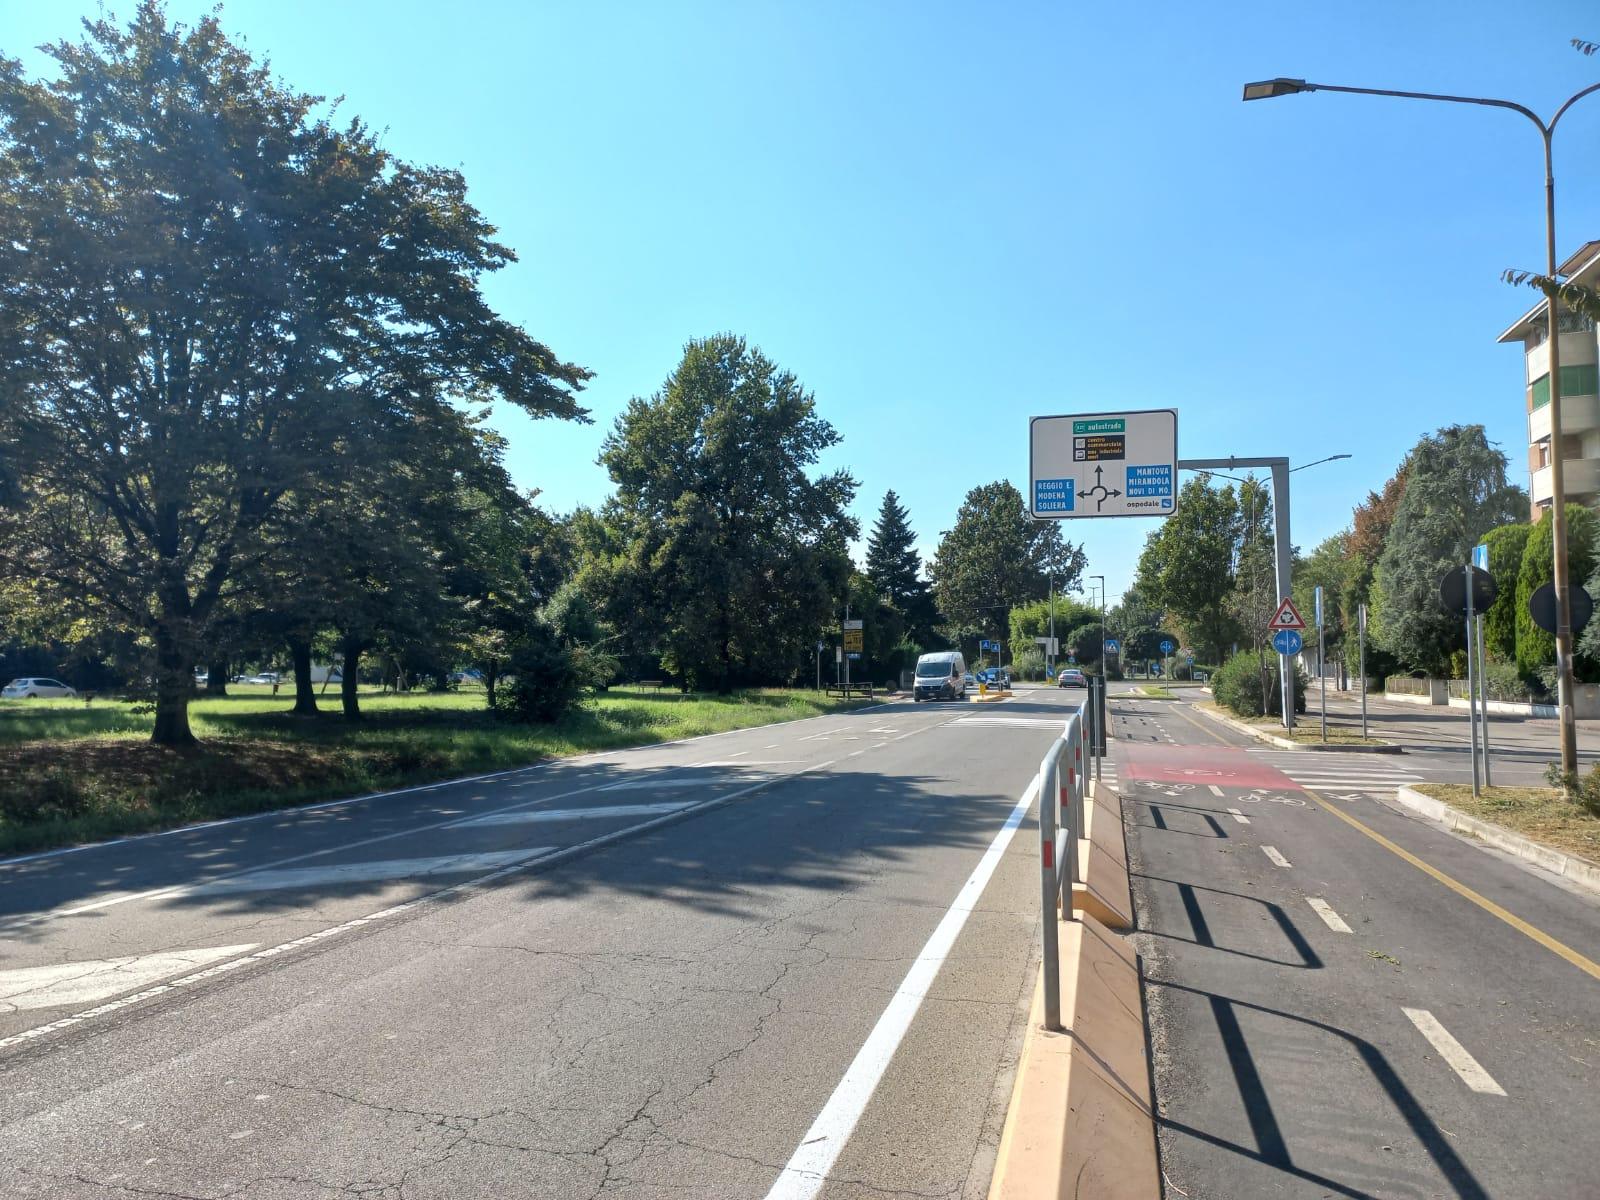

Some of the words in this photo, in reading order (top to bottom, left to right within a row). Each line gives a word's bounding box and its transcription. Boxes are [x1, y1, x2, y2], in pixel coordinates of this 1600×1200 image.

[1087, 422, 1122, 431] autostrada
[1136, 467, 1169, 476] MANTOVA
[1037, 481, 1063, 490] REGGIO
[1128, 477, 1170, 486] MIRANDOLA
[1038, 491, 1066, 500] MODENA
[1128, 487, 1145, 495] NOVI
[1148, 487, 1155, 495] DI
[1126, 500, 1160, 508] ospedale
